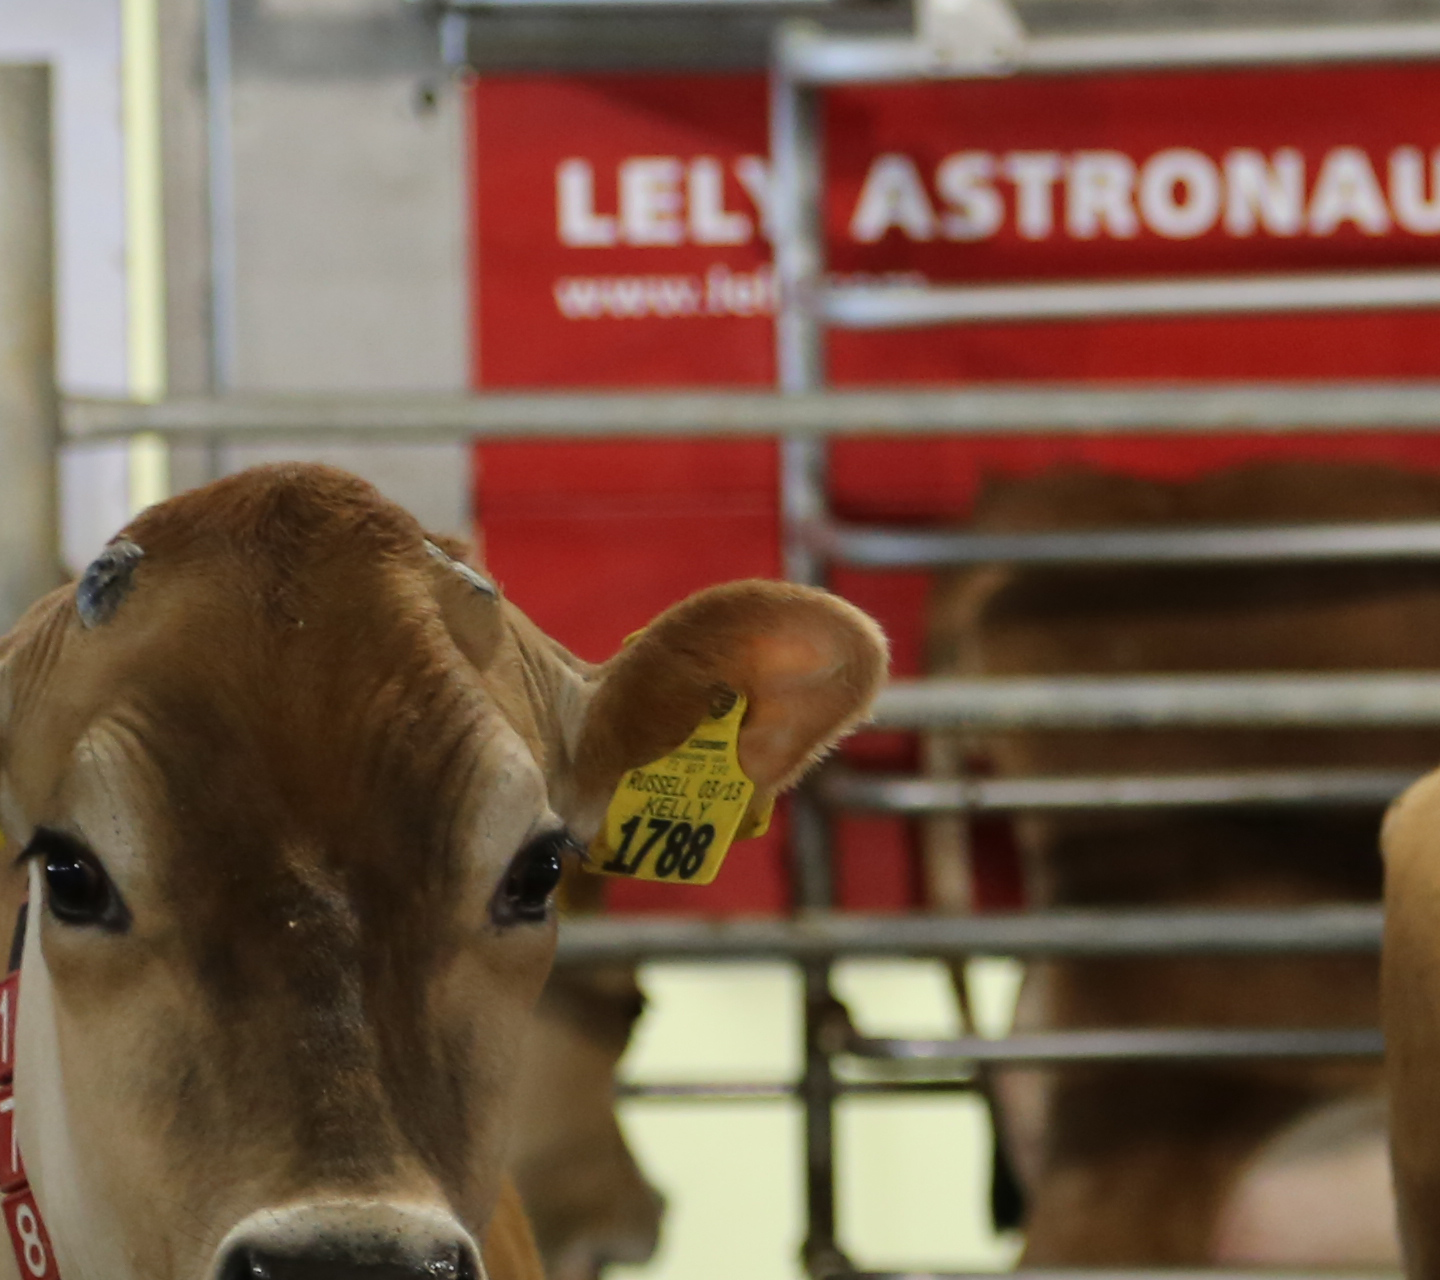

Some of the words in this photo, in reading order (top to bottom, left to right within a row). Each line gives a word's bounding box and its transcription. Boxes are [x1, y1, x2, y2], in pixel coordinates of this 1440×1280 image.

[626, 771, 690, 797] RUSSELL
[640, 796, 712, 820] KELLY
[602, 816, 715, 879] 1788
